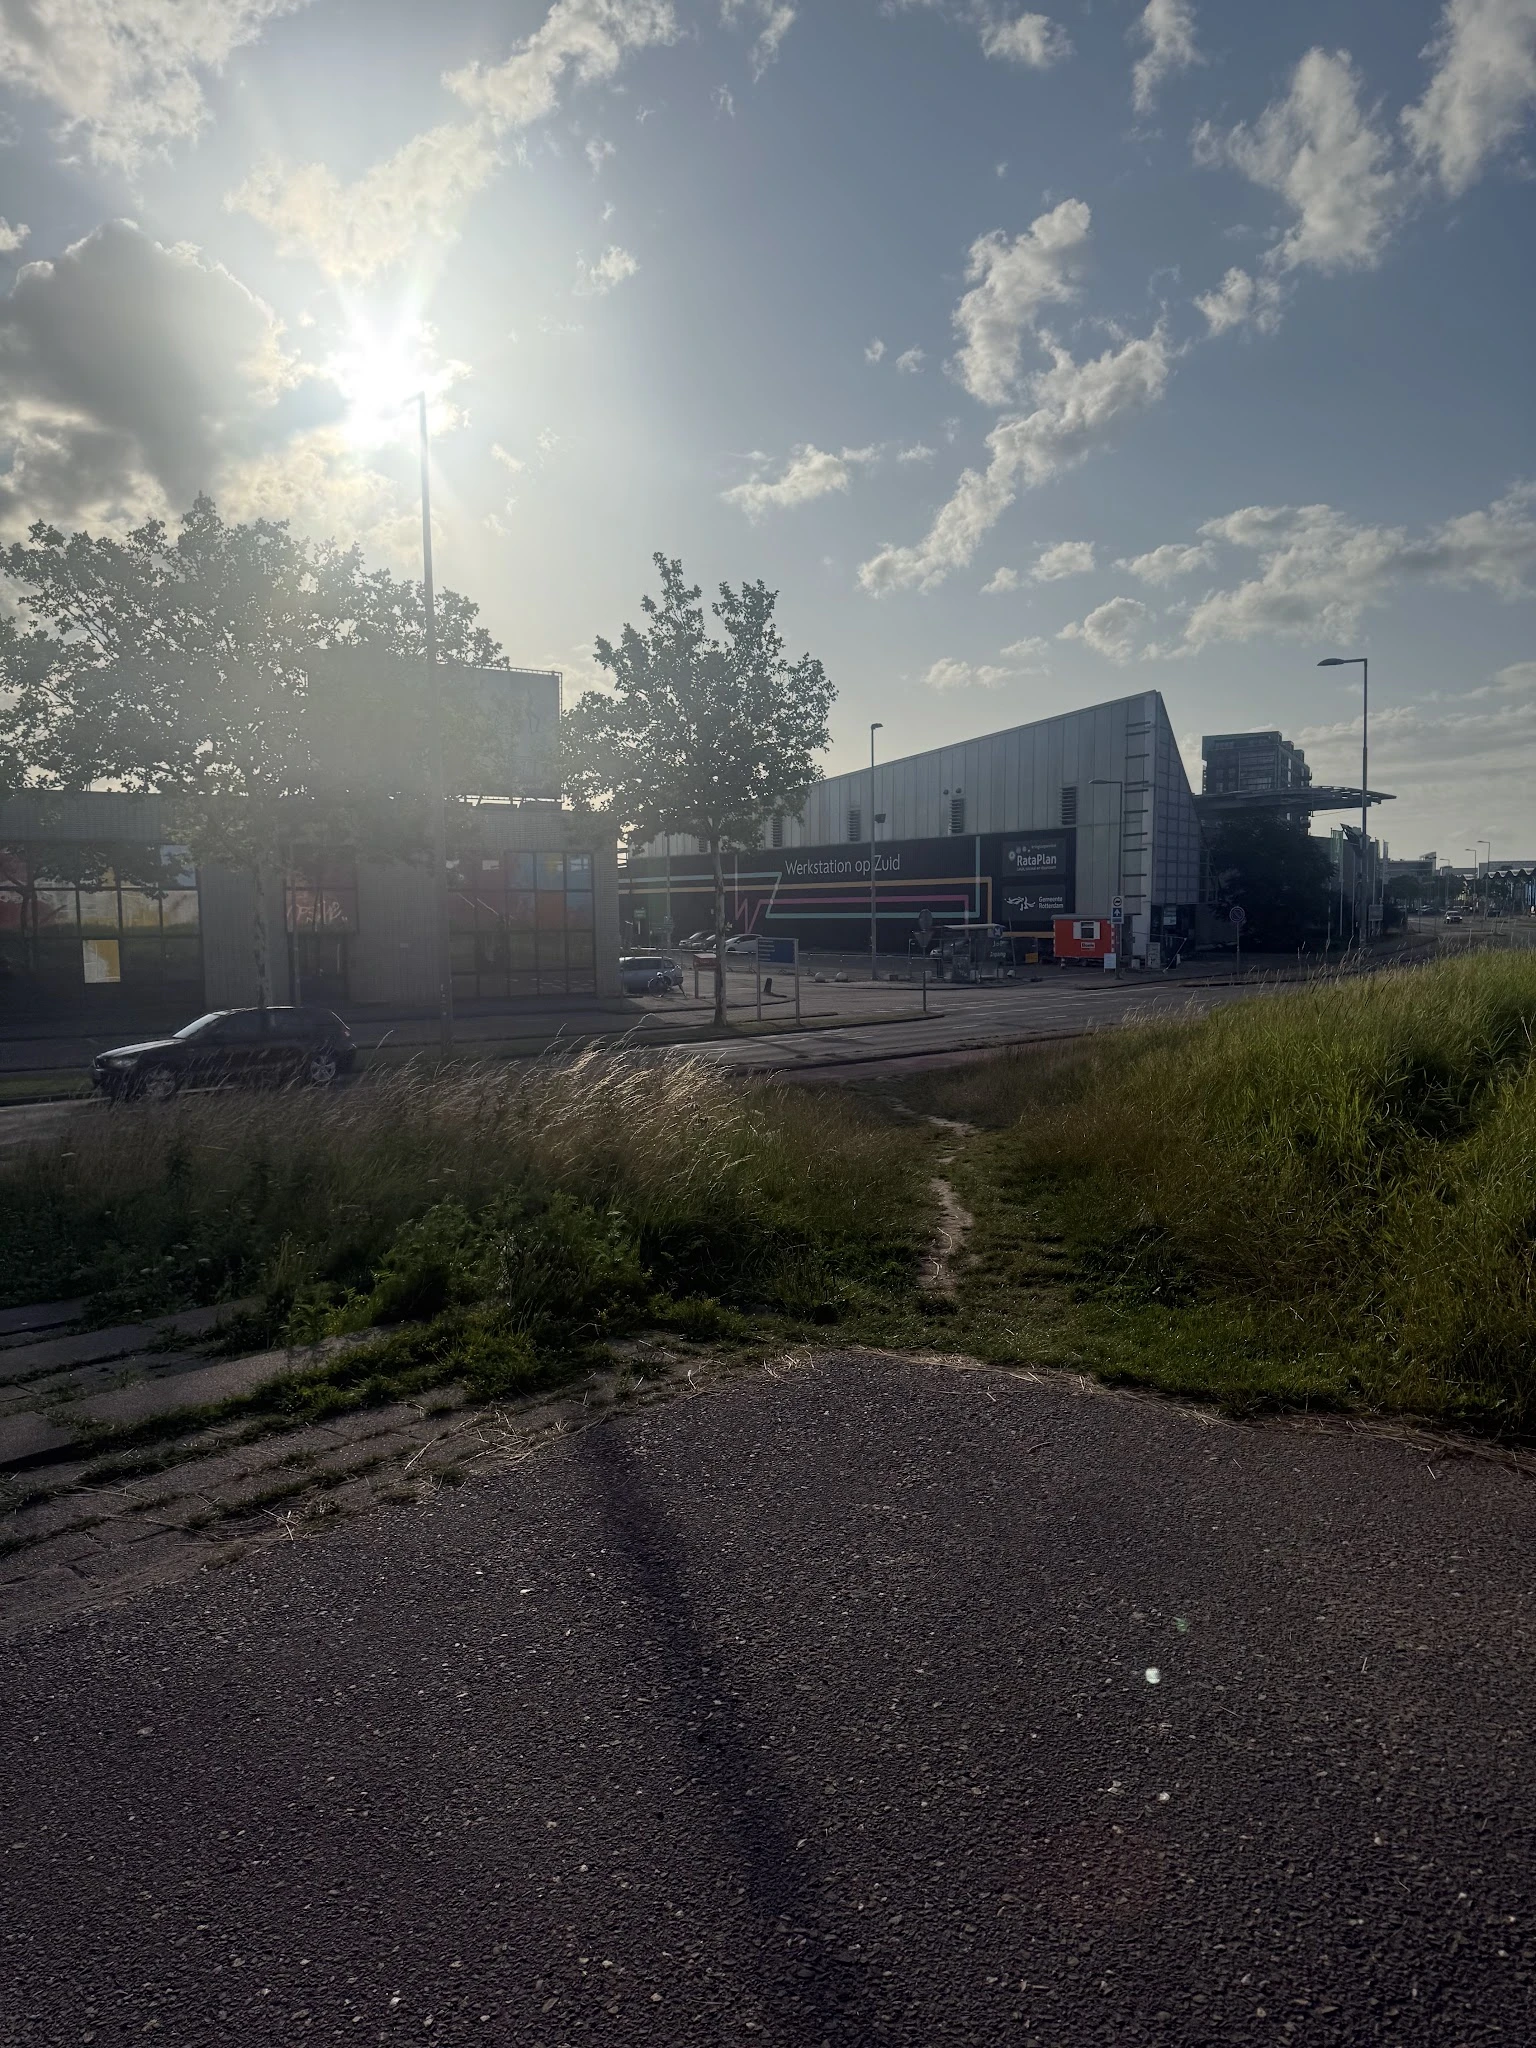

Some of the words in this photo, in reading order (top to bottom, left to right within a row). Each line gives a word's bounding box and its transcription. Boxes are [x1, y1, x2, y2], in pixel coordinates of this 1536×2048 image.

[785, 859, 852, 875] Werkstation
[855, 860, 871, 876] op
[873, 854, 901, 871] Zuid
[1016, 854, 1057, 867] RataPlan
